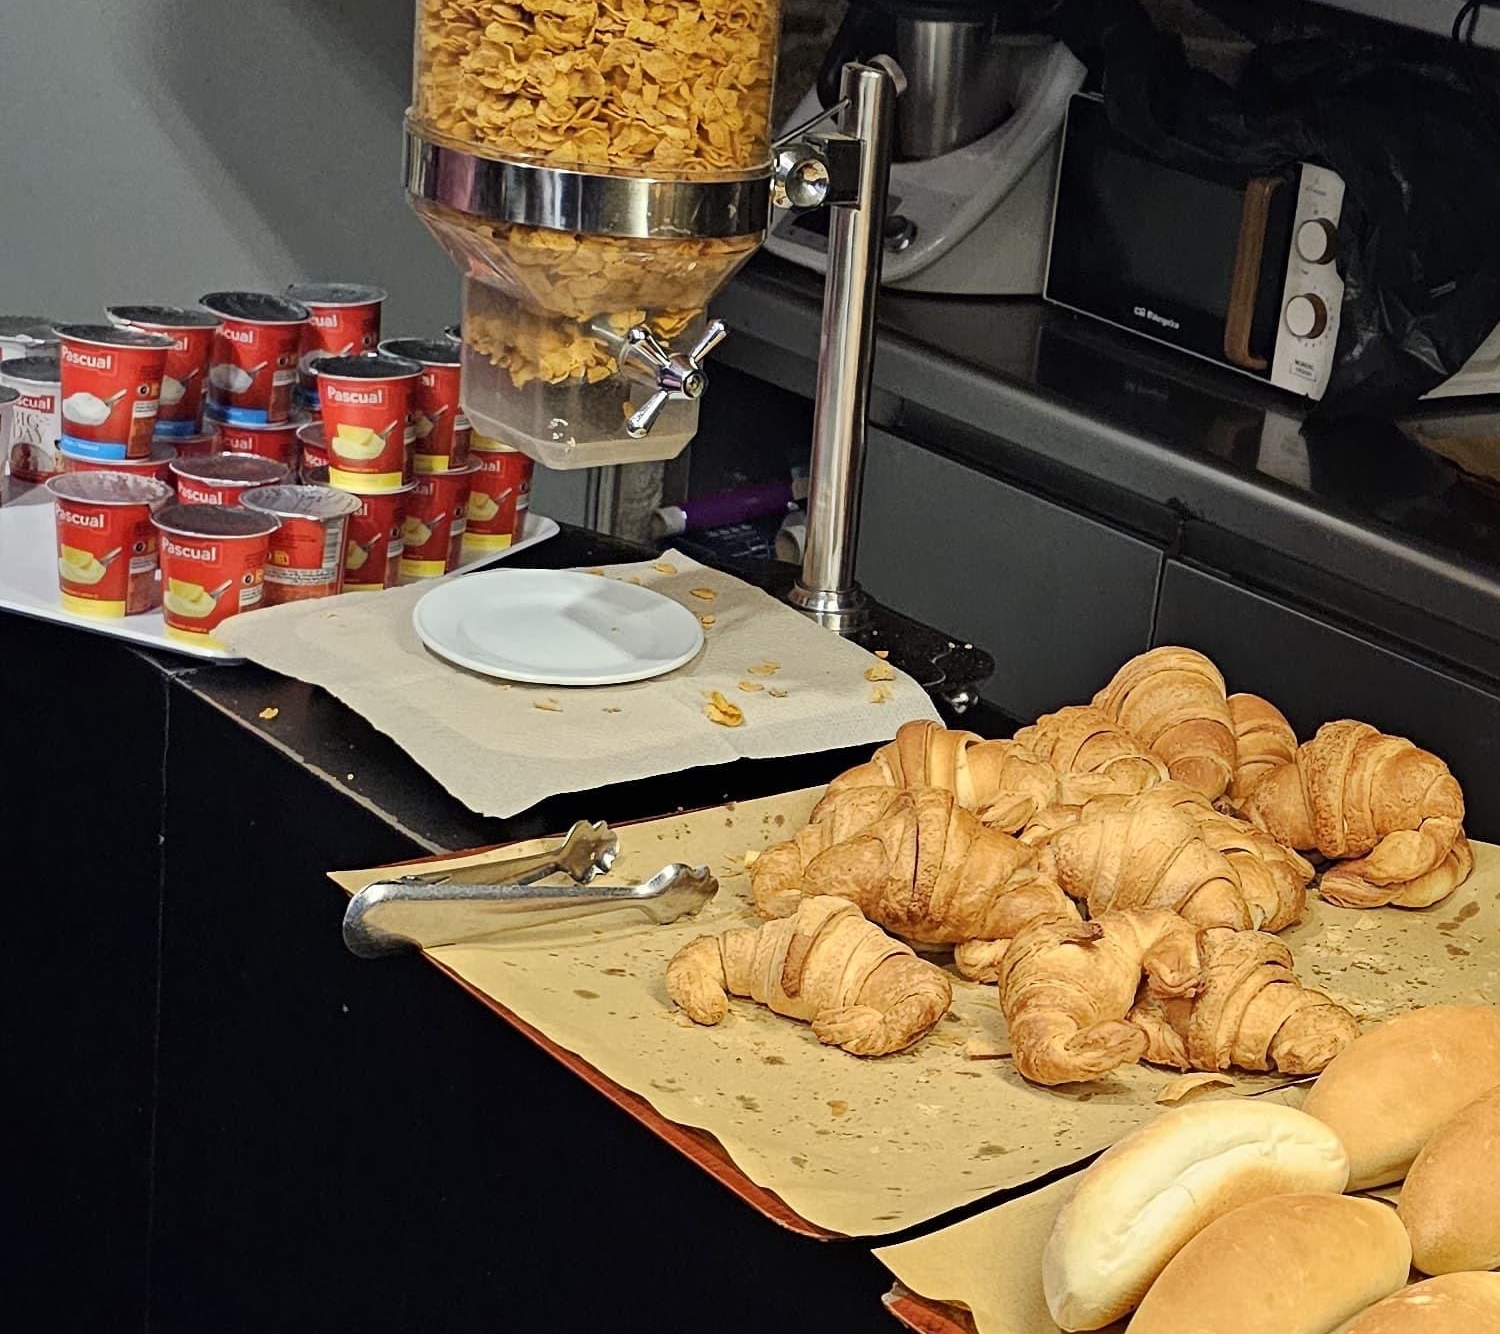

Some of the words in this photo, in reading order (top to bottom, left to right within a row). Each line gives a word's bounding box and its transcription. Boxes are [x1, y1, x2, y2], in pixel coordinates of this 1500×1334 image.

[61, 345, 112, 370] Pascual
[327, 385, 383, 405] Pascual
[178, 481, 222, 505] Pascual
[56, 503, 104, 528] Pascual
[162, 536, 216, 561] Pascual
